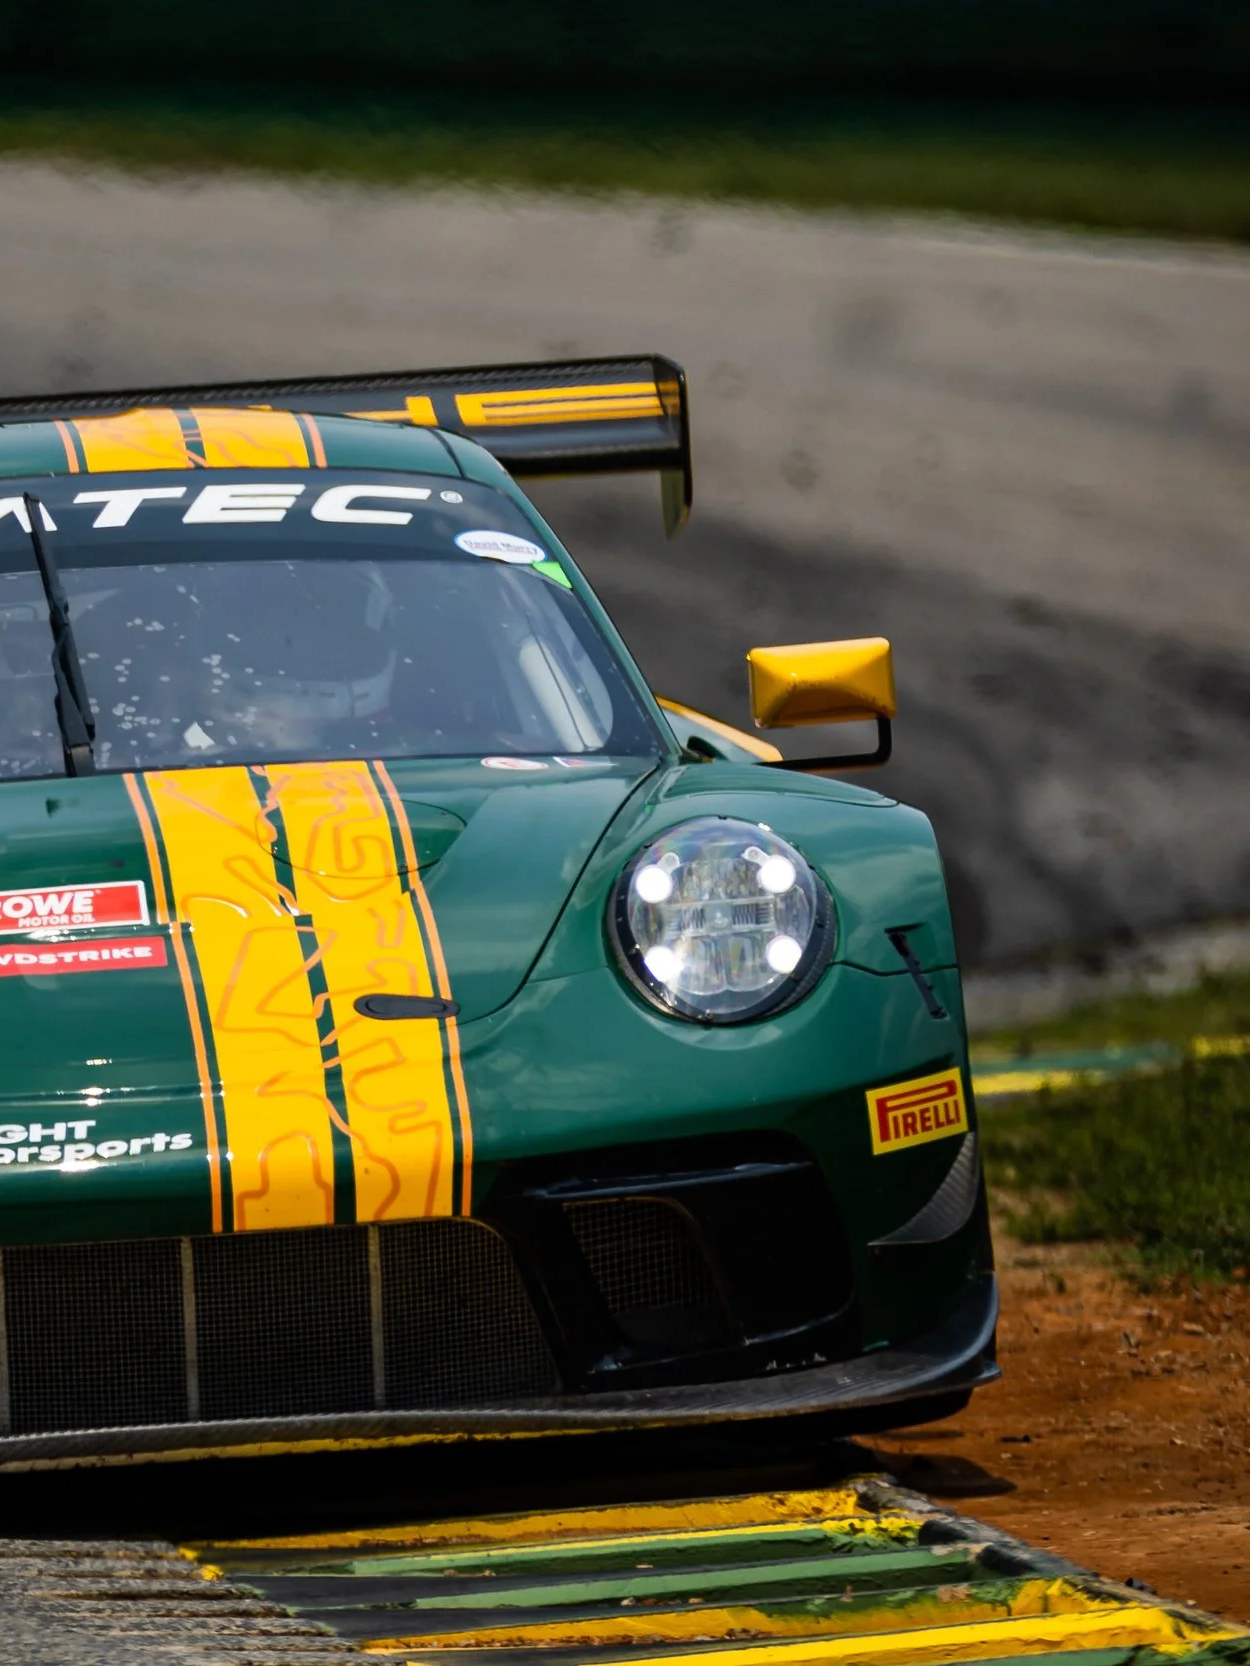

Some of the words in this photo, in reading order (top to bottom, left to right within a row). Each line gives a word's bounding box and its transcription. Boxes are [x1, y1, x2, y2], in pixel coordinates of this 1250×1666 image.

[18, 915, 69, 928] MOTOR
[70, 913, 95, 924] OIL
[876, 1080, 960, 1143] PIRELLI
